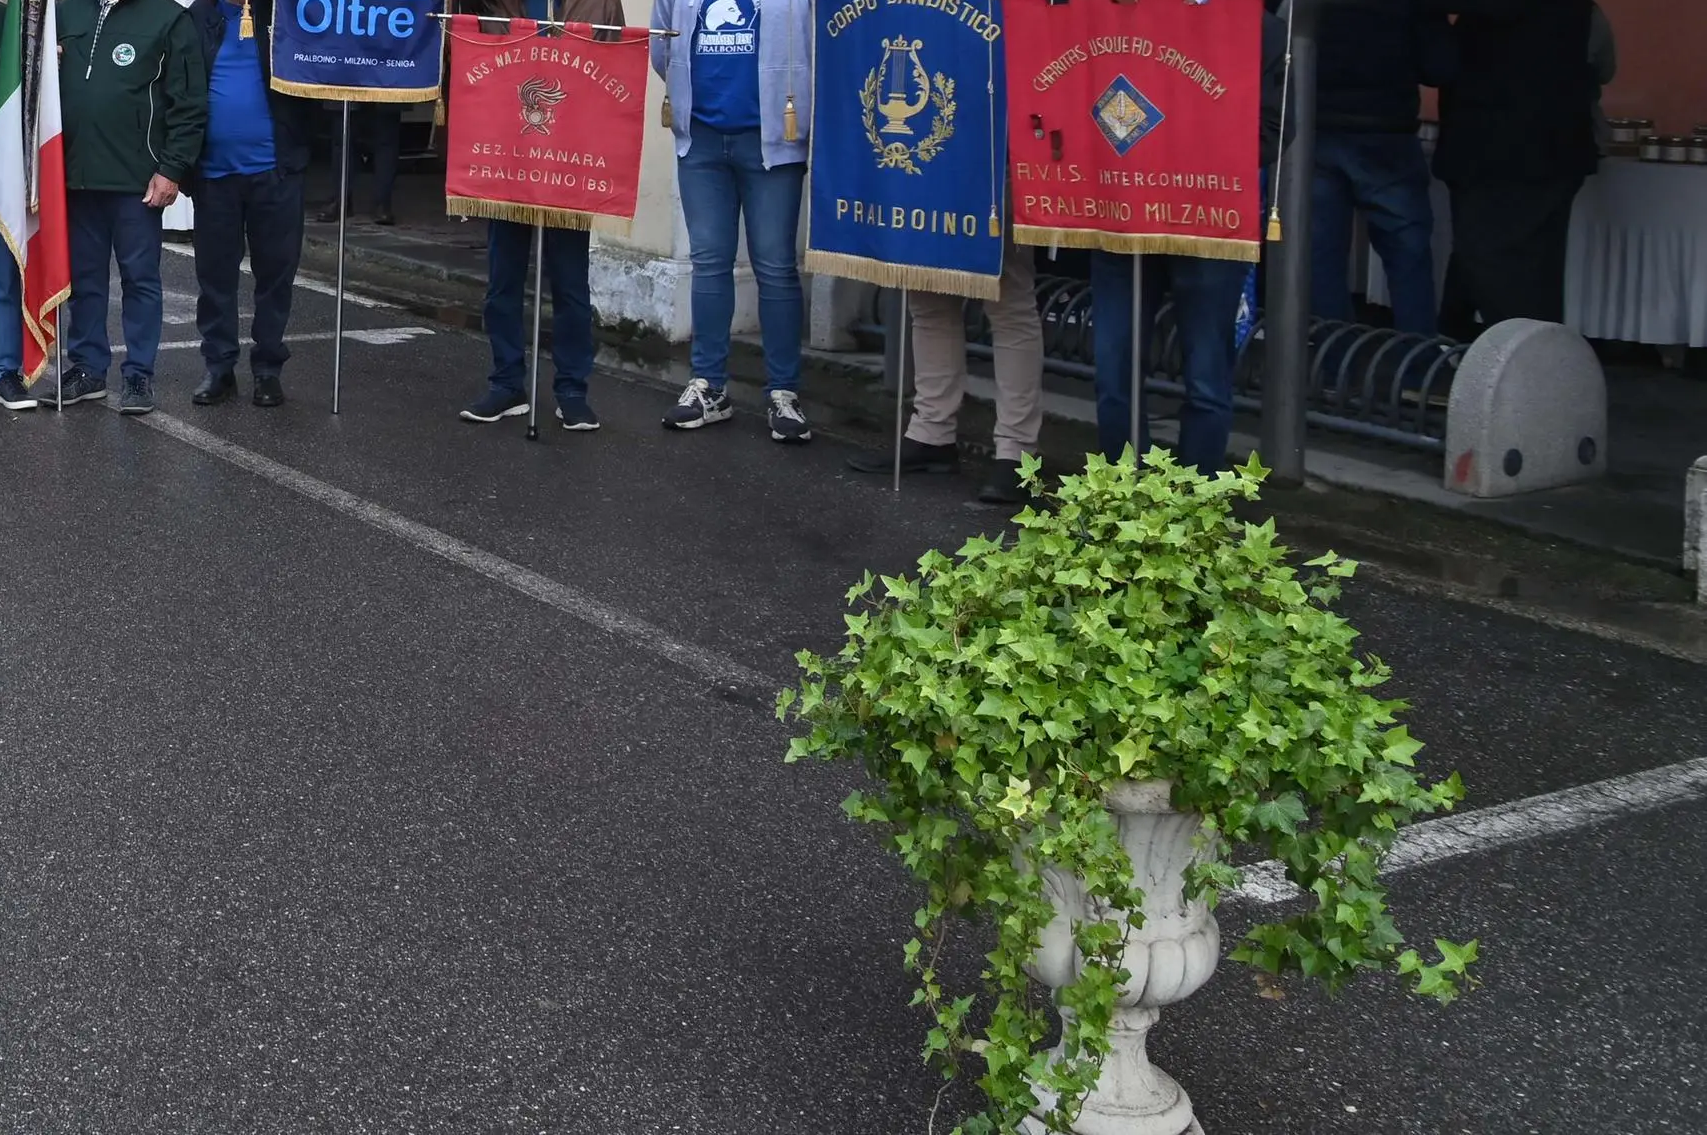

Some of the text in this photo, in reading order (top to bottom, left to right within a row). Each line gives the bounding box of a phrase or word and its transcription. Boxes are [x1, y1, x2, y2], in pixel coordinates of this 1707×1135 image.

[294, 53, 337, 64] PRALBOINO
[344, 57, 378, 66] MILZANO
[386, 59, 415, 68] SENIGA
[698, 44, 753, 53] PRALBOINO
[465, 46, 631, 104] ASS. NAZ. BERSAGLIERI
[1033, 36, 1227, 101] CHARITAS USQUE AD SANGUINEM
[472, 142, 607, 168] SEZ. L. MANARA
[468, 164, 615, 194] PRALBOINO (BS)
[1016, 162, 1243, 192] A.V.I.S. INTERCOMUNALE
[835, 198, 977, 237] PRALBOINO
[1024, 195, 1241, 230] PRALBOINO MILZANO
